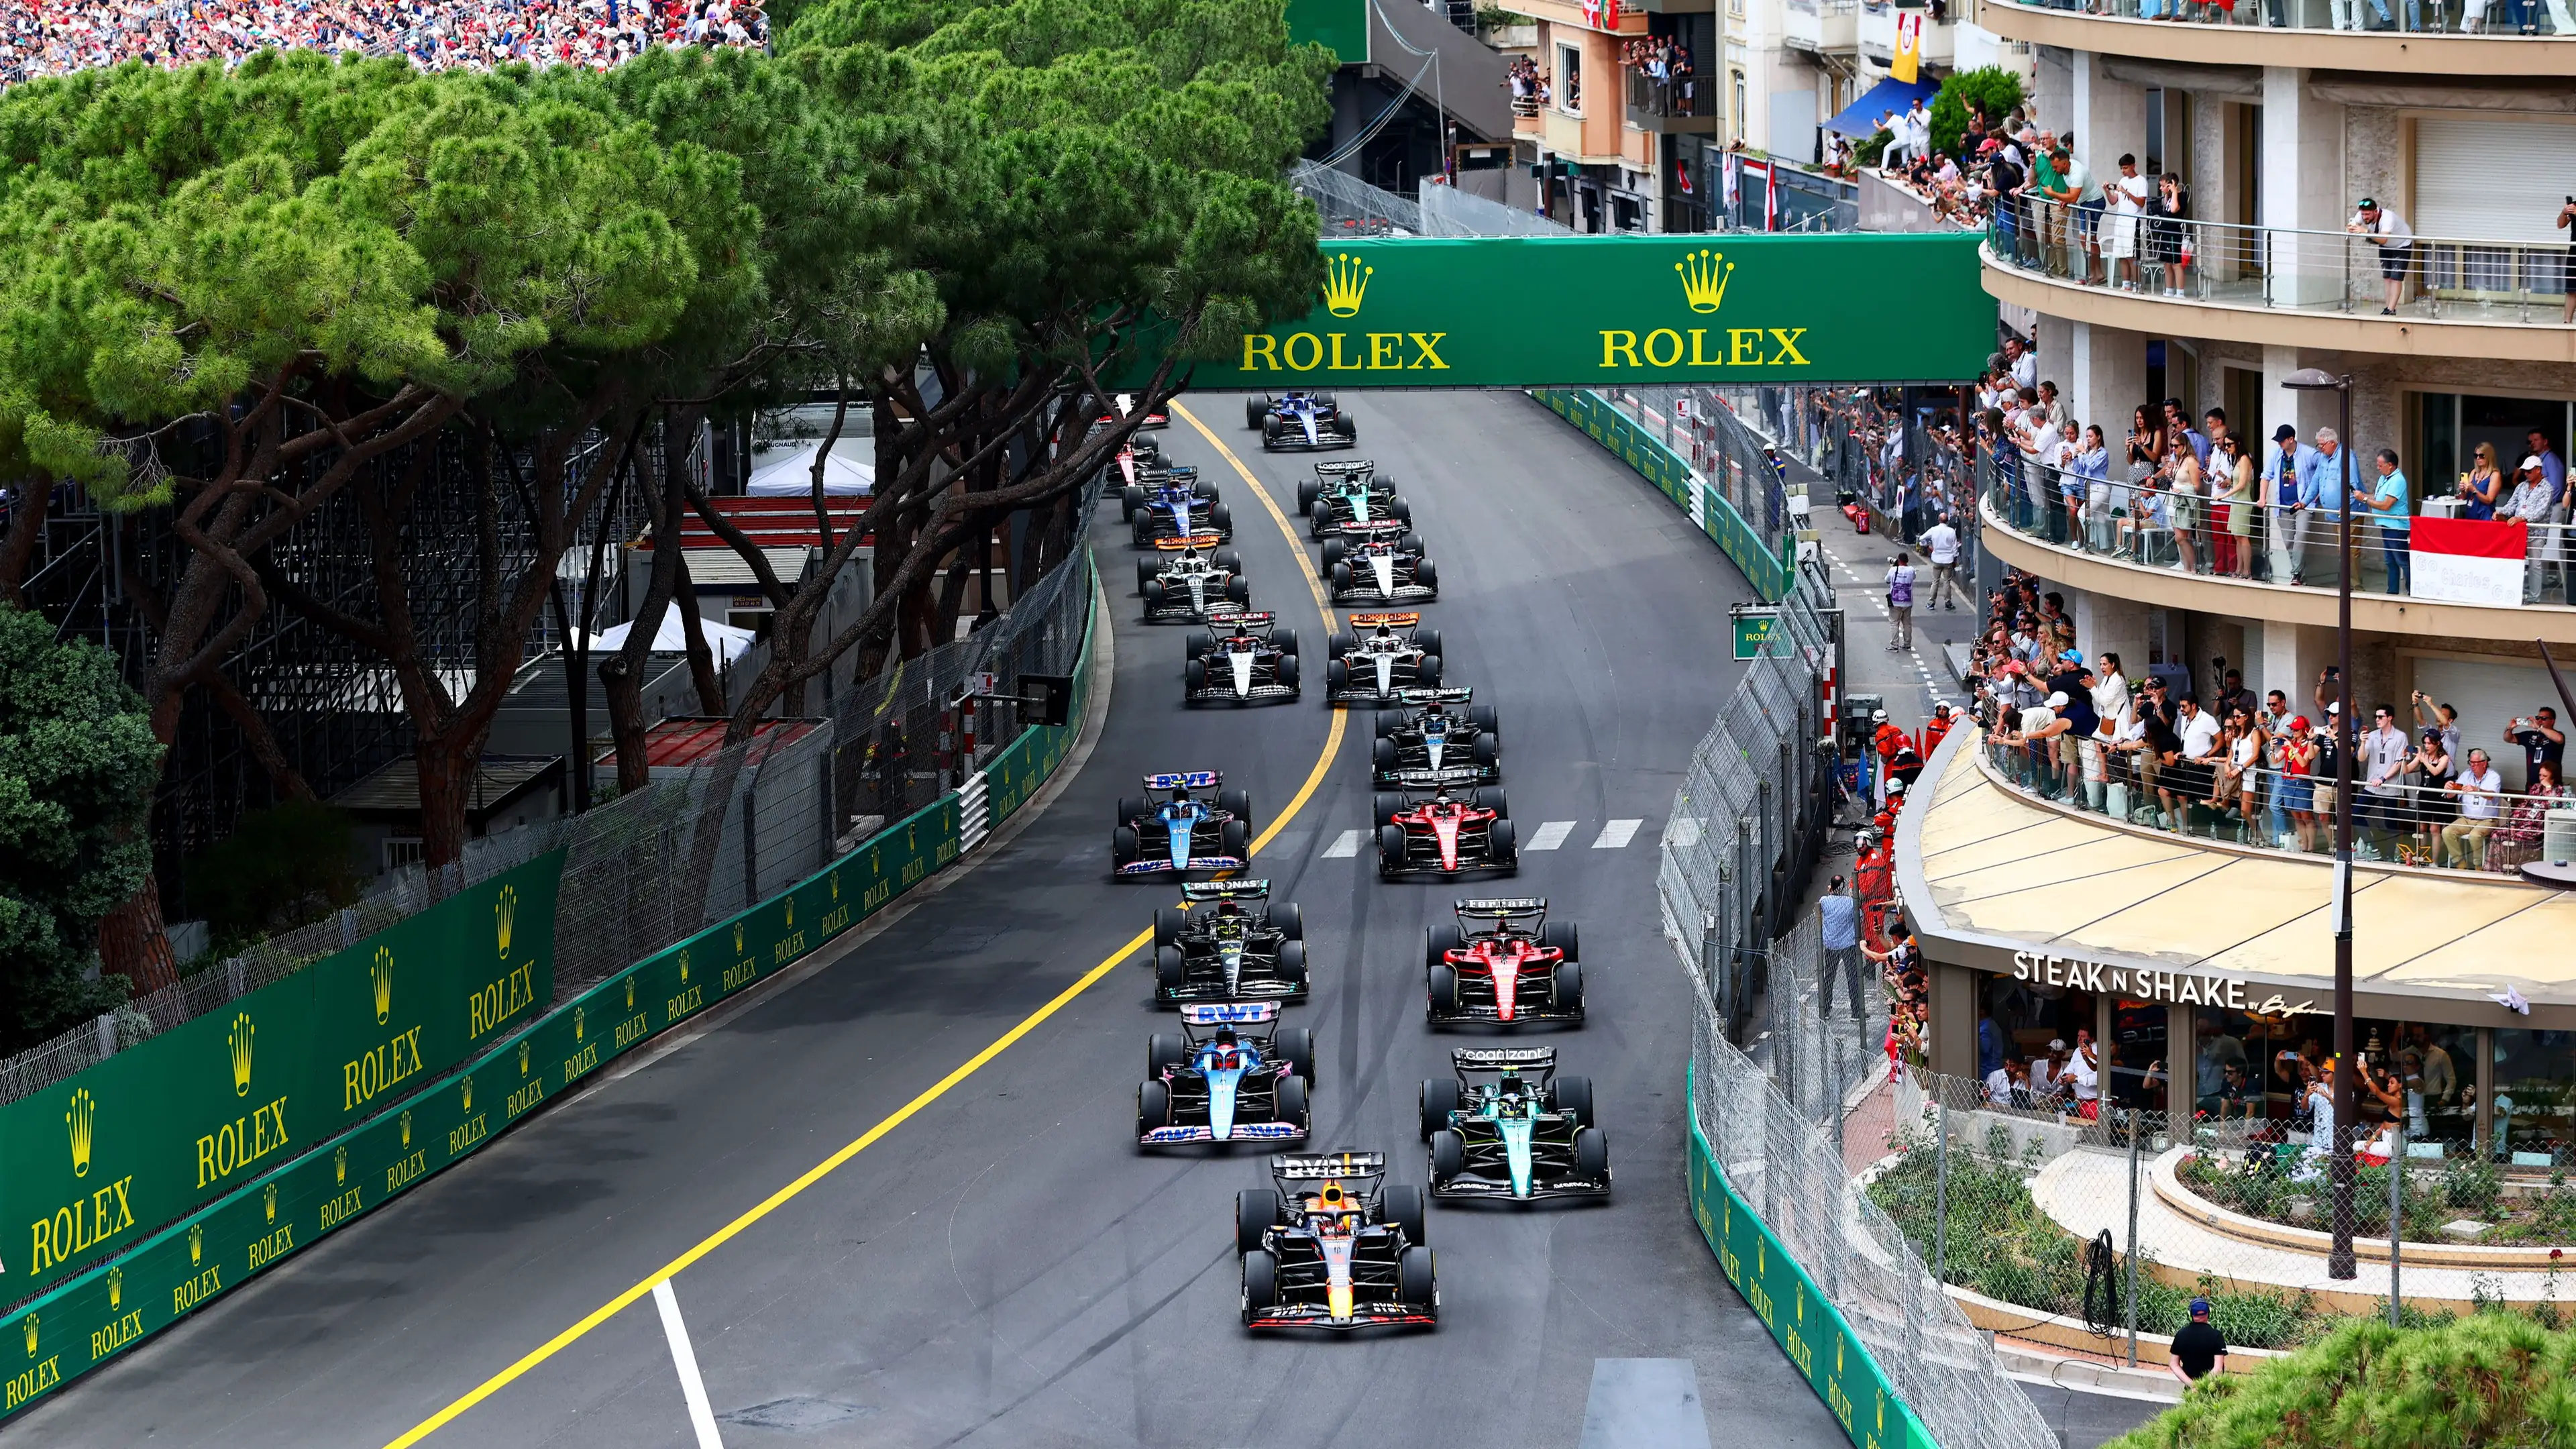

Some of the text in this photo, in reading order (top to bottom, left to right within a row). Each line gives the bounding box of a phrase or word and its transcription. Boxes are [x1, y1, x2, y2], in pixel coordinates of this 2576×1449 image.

[1240, 333, 1449, 370] ROLEX
[1600, 329, 1810, 367] ROLEX
[2416, 555, 2438, 572] Go
[2492, 584, 2515, 602] Go
[1409, 688, 1461, 696] PETRONAS
[1022, 770, 1036, 797] ROLEX
[1157, 773, 1209, 787] BWT
[1410, 769, 1466, 779] Ferrari
[999, 789, 1016, 817] ROLEX
[937, 837, 956, 865] ROLEX
[902, 856, 923, 885] ROLEX
[1195, 880, 1256, 890] PETRONAS
[865, 878, 889, 910] ROLEX
[1468, 899, 1533, 908] Ferrari
[822, 903, 848, 936] ROLEX
[775, 930, 804, 961] ROLEX
[723, 956, 755, 990] ROLEX
[2012, 951, 2107, 992] STEAK
[2112, 969, 2127, 991] N
[2135, 969, 2246, 1009] SHAKE
[2248, 1001, 2260, 1010] BY
[470, 961, 533, 1039] ROLEX
[667, 985, 702, 1020] ROLEX
[1197, 1005, 1263, 1021] BWT
[615, 1012, 647, 1049] ROLEX
[343, 1025, 422, 1111] ROLEX
[565, 1042, 598, 1084] ROLEX
[1466, 1048, 1547, 1065] cognizant
[508, 1077, 543, 1118] ROLEX
[197, 1096, 288, 1188] ROLEX
[449, 1114, 486, 1155] ROLEX
[387, 1149, 425, 1191] ROLEX
[1285, 1153, 1372, 1177] BYBIT
[31, 1175, 134, 1277] ROLEX
[321, 1186, 362, 1230] ROLEX
[249, 1224, 293, 1269] ROLEX
[1720, 1240, 1740, 1287] ROLEX
[174, 1265, 221, 1313] ROLEX
[1750, 1277, 1773, 1330] ROLEX
[92, 1309, 143, 1359] ROLEX
[1787, 1323, 1812, 1378] ROLEX
[6, 1356, 60, 1409] ROLEX
[1828, 1375, 1853, 1433] ROLEX
